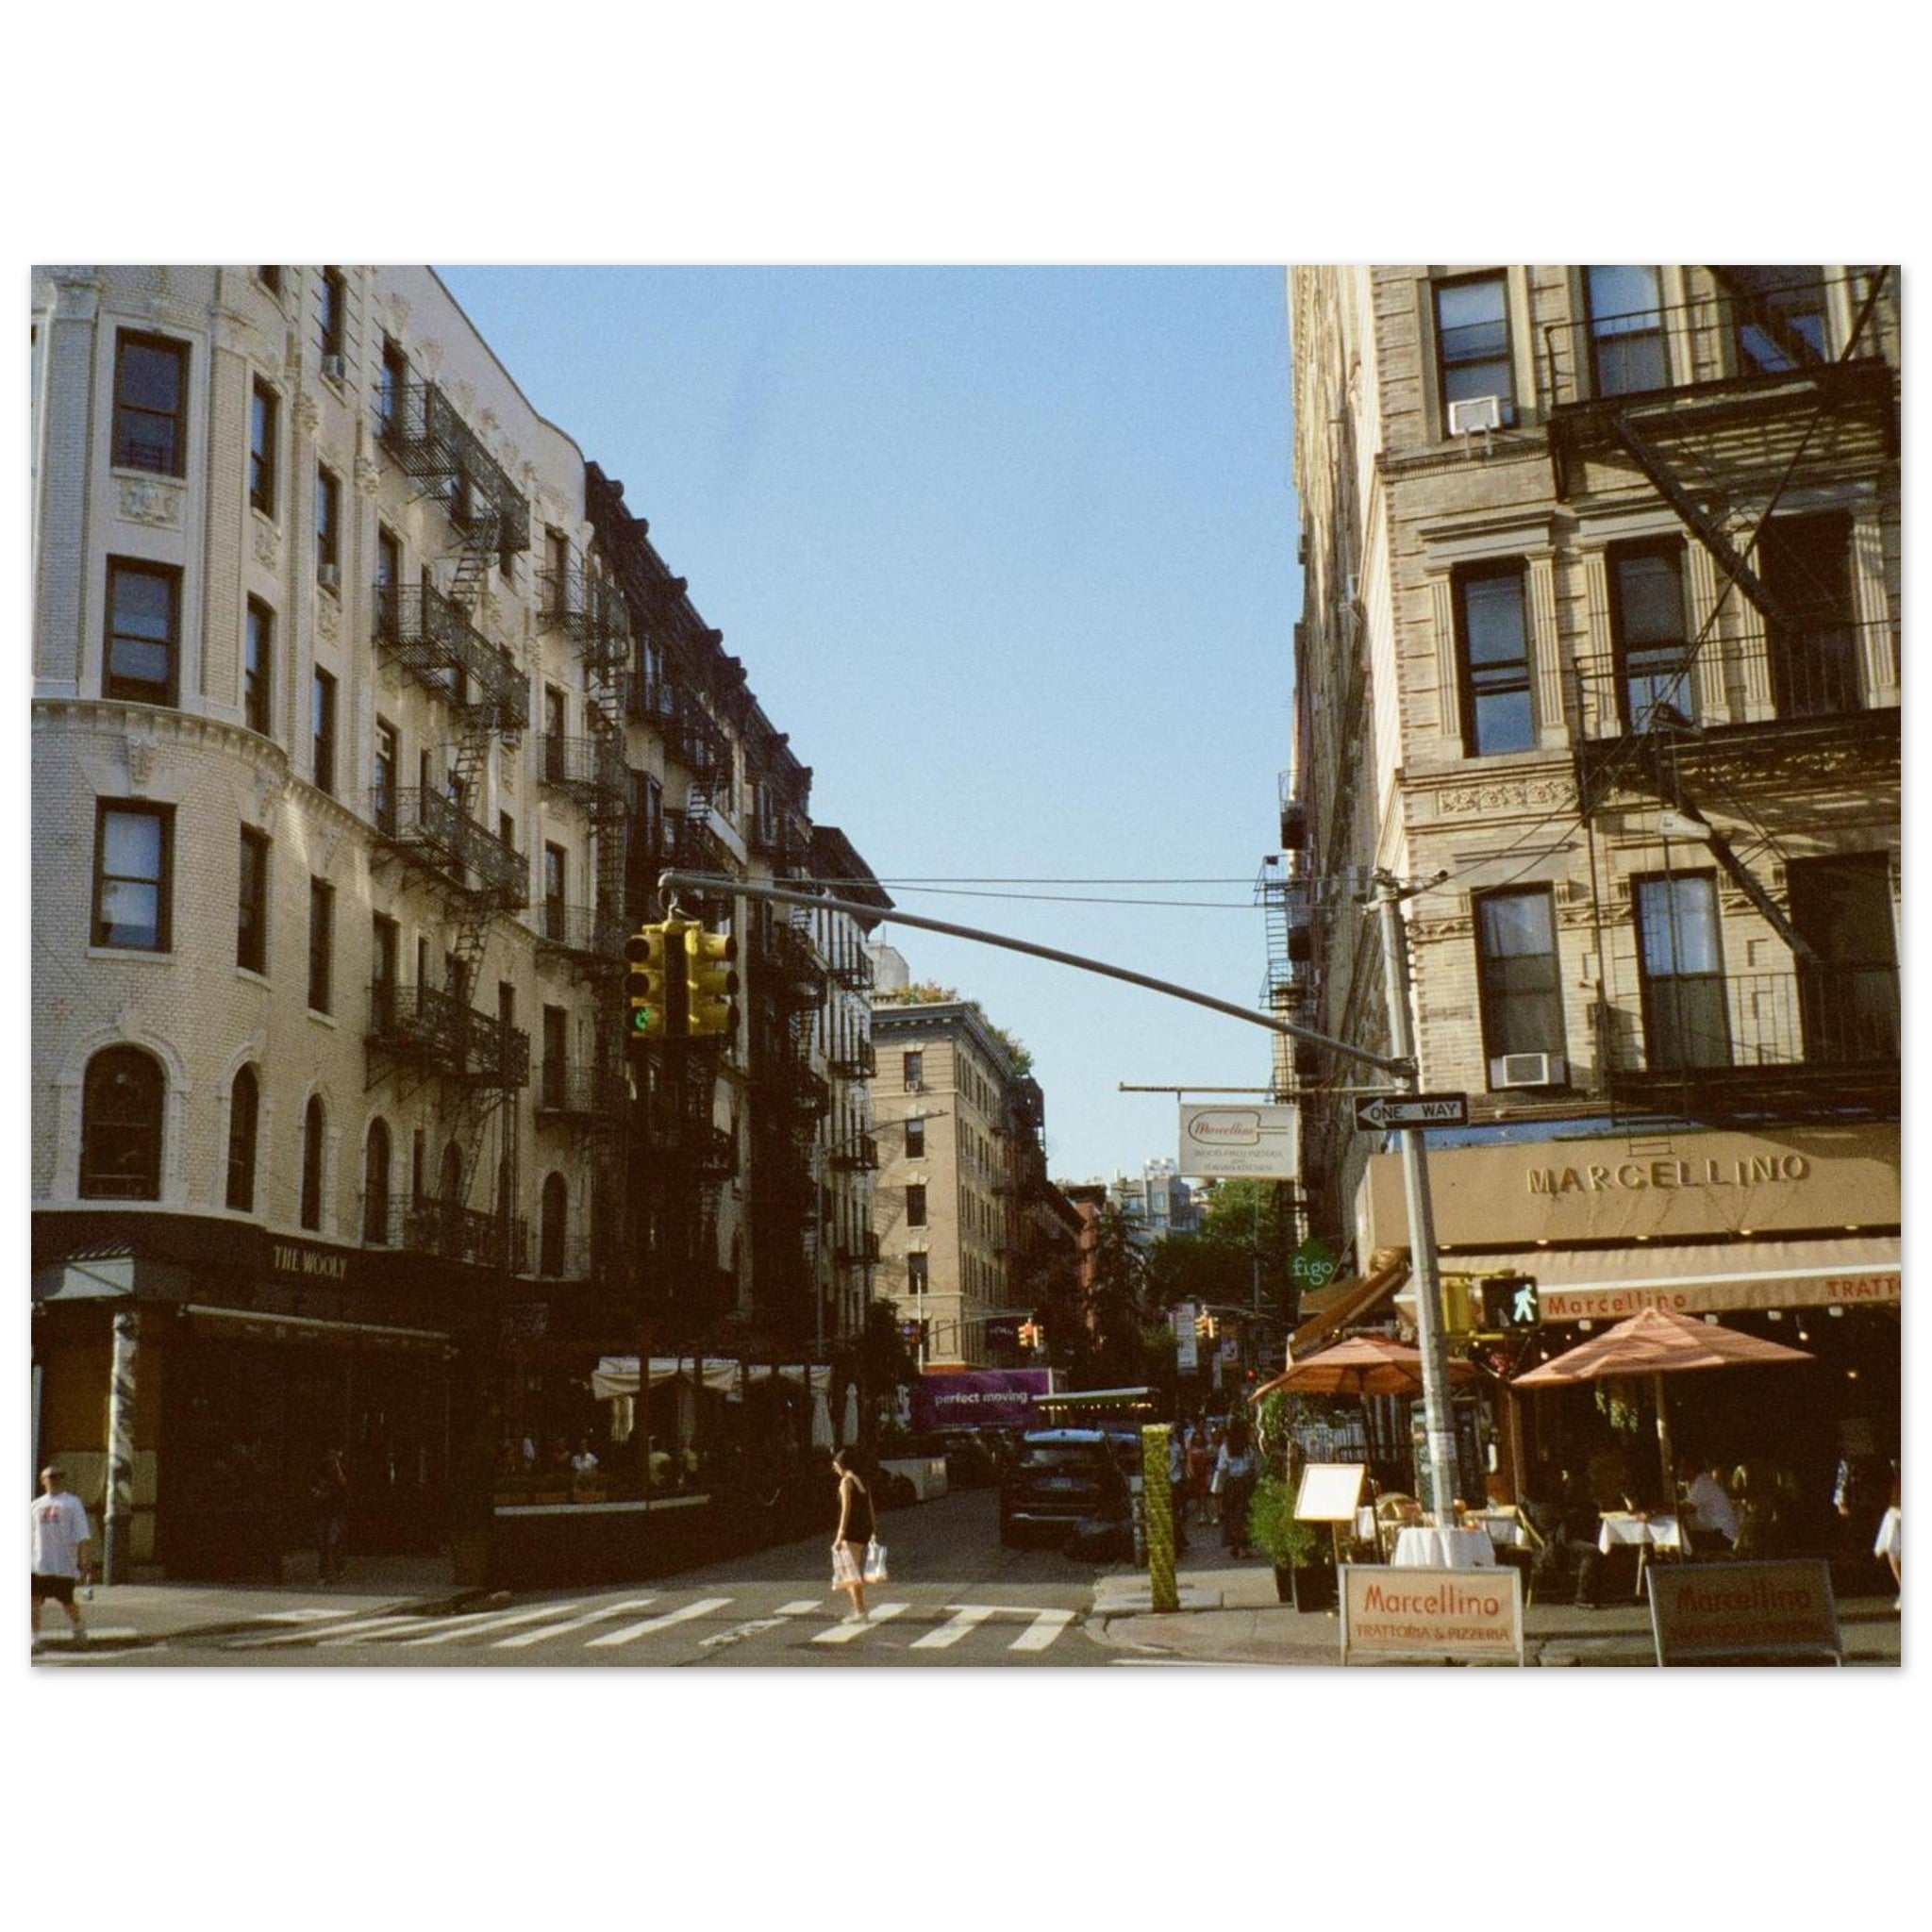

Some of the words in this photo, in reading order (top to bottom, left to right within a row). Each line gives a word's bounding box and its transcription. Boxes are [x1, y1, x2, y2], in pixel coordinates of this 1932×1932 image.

[1370, 1105, 1405, 1121] ONE
[1422, 1102, 1457, 1118] WAY
[1526, 1155, 1810, 1193] MARCELLINO
[274, 1245, 299, 1272] THE
[303, 1250, 347, 1280] WOOLY
[1292, 1257, 1333, 1285] figo
[1547, 1291, 1687, 1315] Marcellino
[934, 1391, 980, 1407] perfect
[982, 1390, 1028, 1405] moving
[1364, 1584, 1500, 1616] Marcellino
[1356, 1624, 1429, 1639] TRATTORIA
[1433, 1625, 1445, 1640] &
[1446, 1626, 1509, 1641] PIZZERIA
